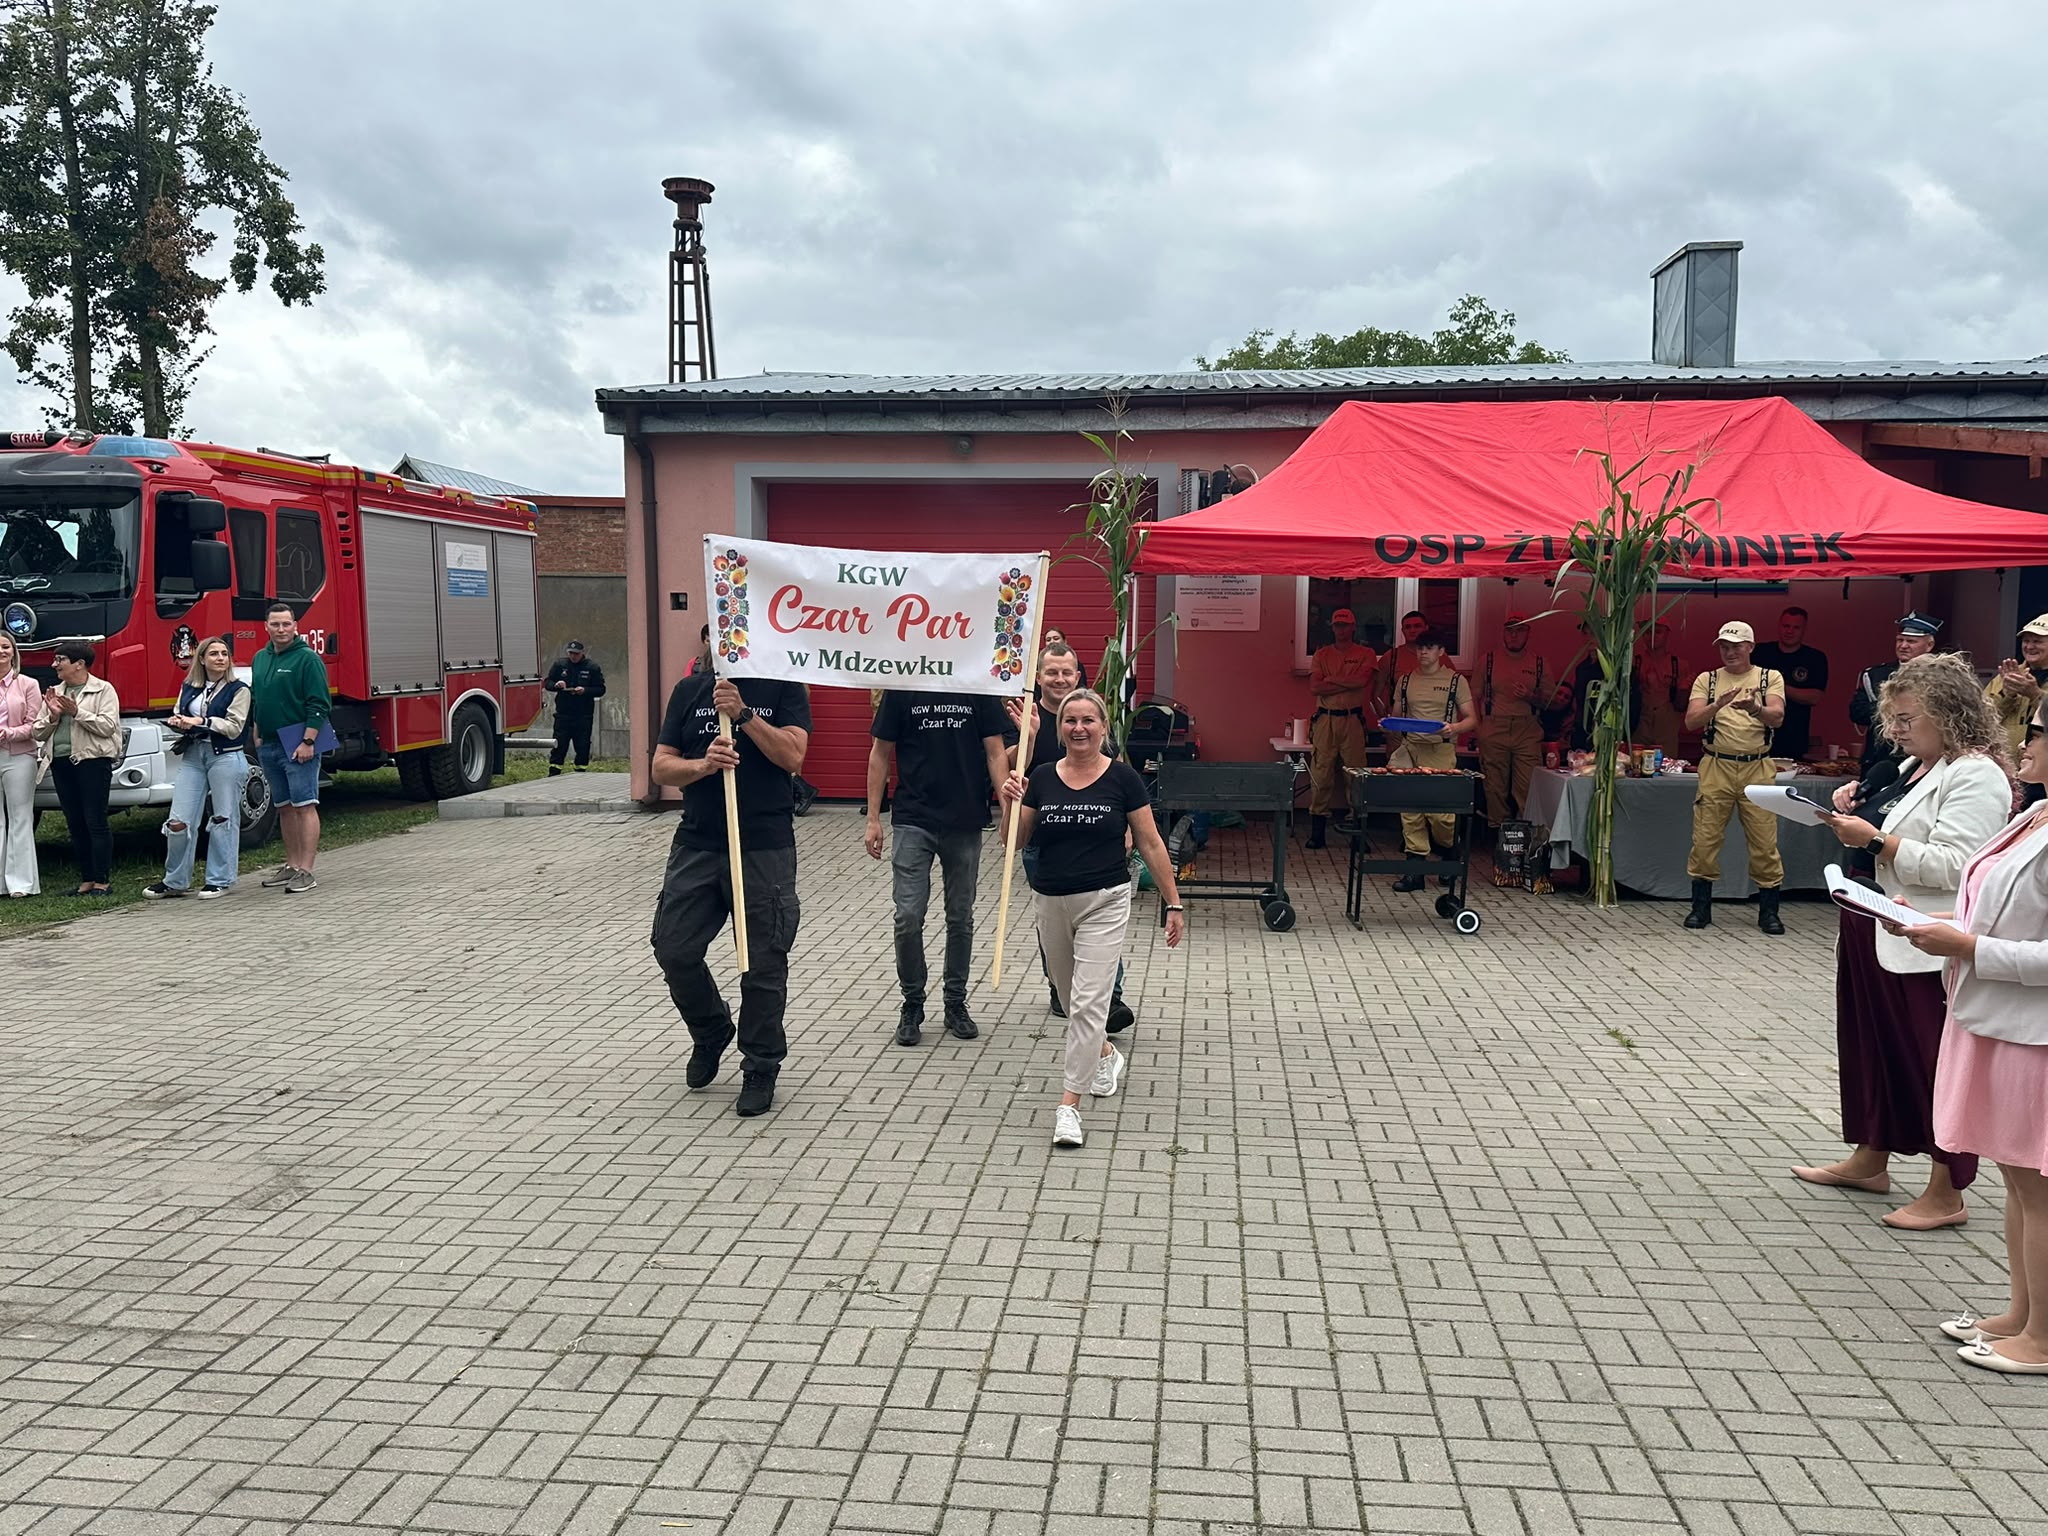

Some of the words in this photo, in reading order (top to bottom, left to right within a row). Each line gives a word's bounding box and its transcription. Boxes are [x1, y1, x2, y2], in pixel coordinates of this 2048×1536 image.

[1374, 533, 1487, 566] OSP
[837, 562, 908, 587] KGW
[767, 584, 873, 634] Czar
[886, 593, 975, 642] Par
[787, 650, 810, 667] w
[818, 648, 953, 676] Mdzewku
[695, 707, 718, 718] KGW
[911, 705, 931, 715] KGW
[1040, 804, 1060, 812] KGW
[1062, 804, 1112, 813] MDZEWKO
